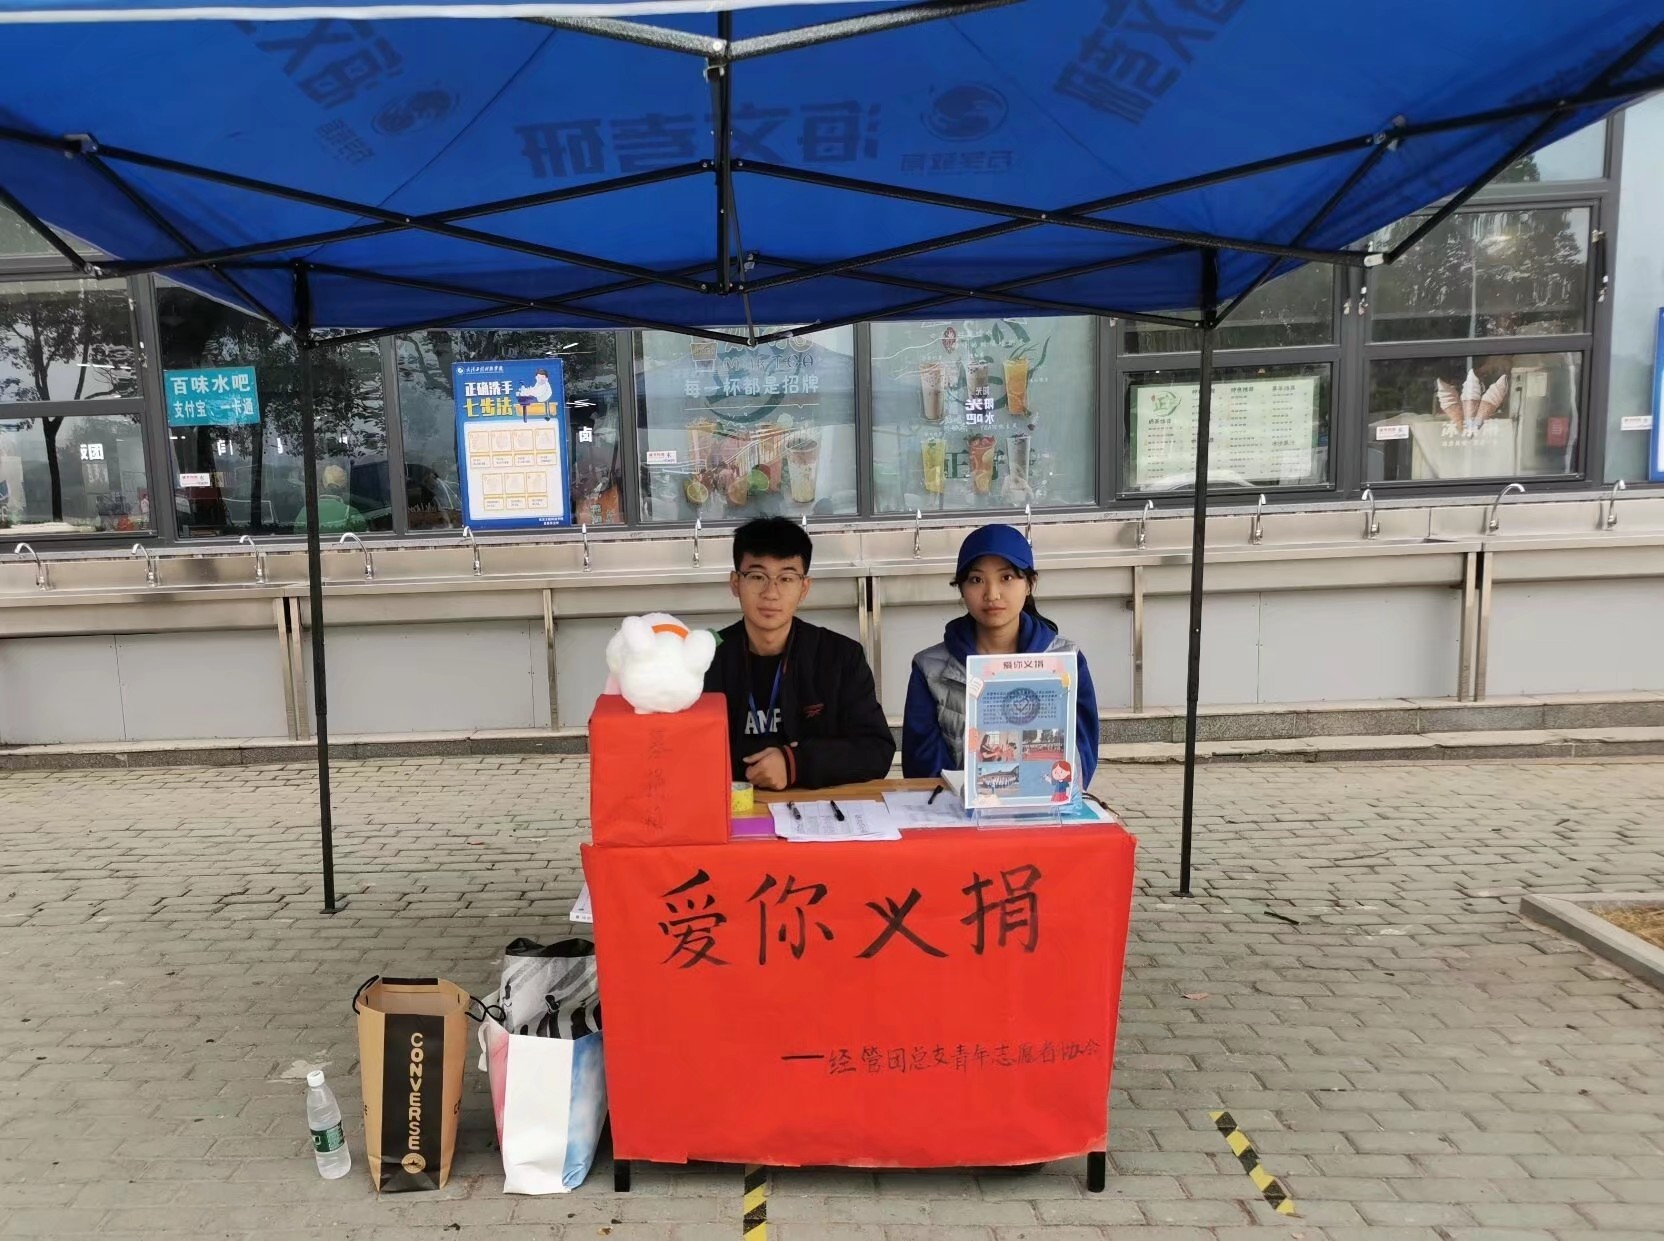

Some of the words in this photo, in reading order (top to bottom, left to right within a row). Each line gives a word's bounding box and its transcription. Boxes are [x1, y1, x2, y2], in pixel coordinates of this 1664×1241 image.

[170, 374, 251, 395] 百味水吧
[464, 380, 513, 397] 正确洗手
[684, 375, 819, 398] 每一杯都是招牌
[173, 397, 254, 419] 支付宝、一卡通
[464, 397, 513, 417] 七步法
[1003, 659, 1044, 669] 爱你义捐
[658, 863, 1043, 968] 爱你义捐
[408, 1032, 425, 1151] CONVERSE
